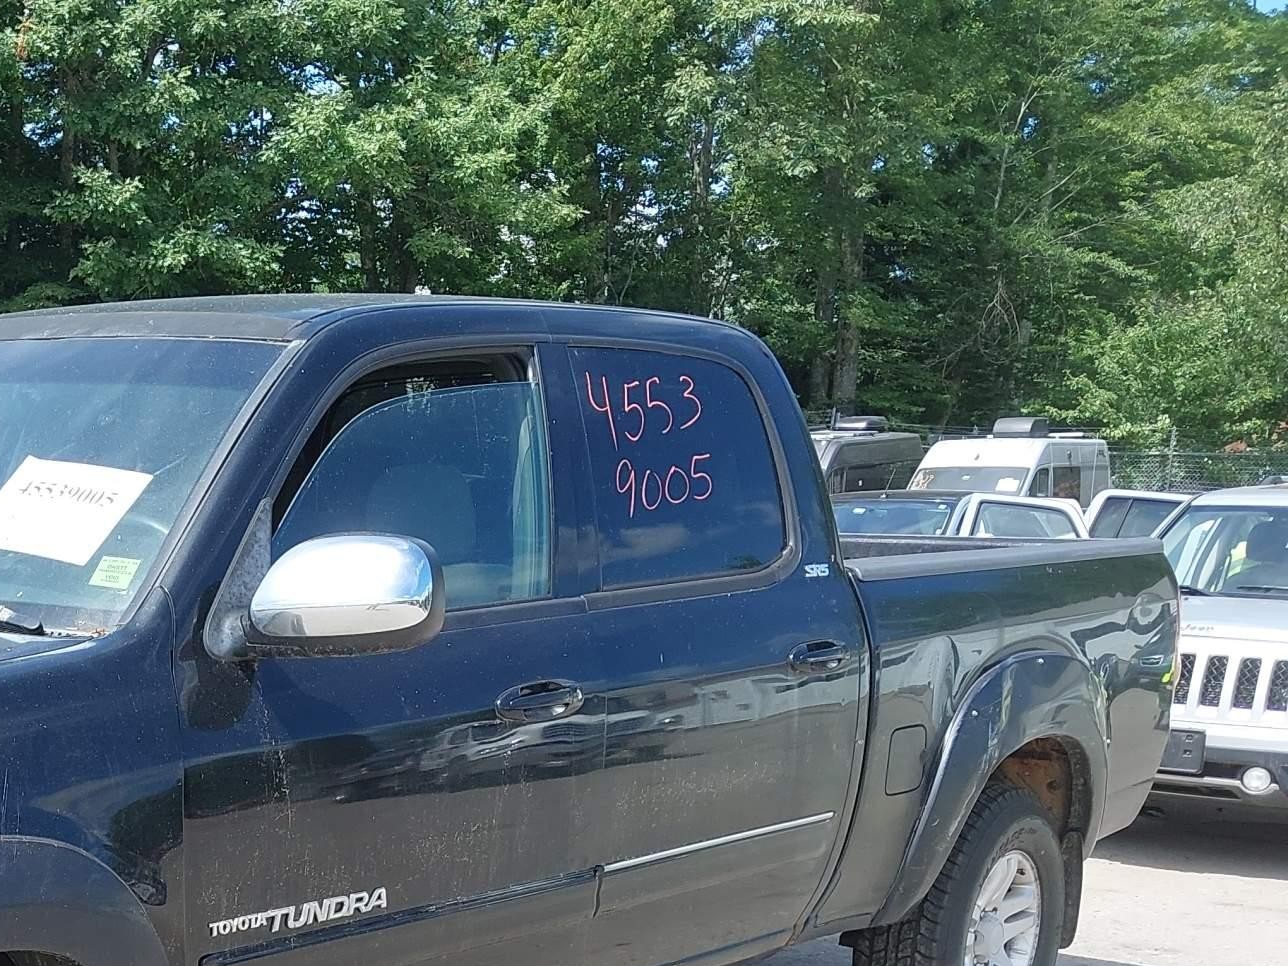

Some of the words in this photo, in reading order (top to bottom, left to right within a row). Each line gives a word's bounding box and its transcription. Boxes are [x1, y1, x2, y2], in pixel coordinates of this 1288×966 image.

[585, 371, 704, 452] 4553
[19, 480, 120, 508] 45539005
[615, 453, 713, 519] 9005
[208, 910, 268, 938] TOYOTA
[264, 886, 389, 934] TUNDRA
